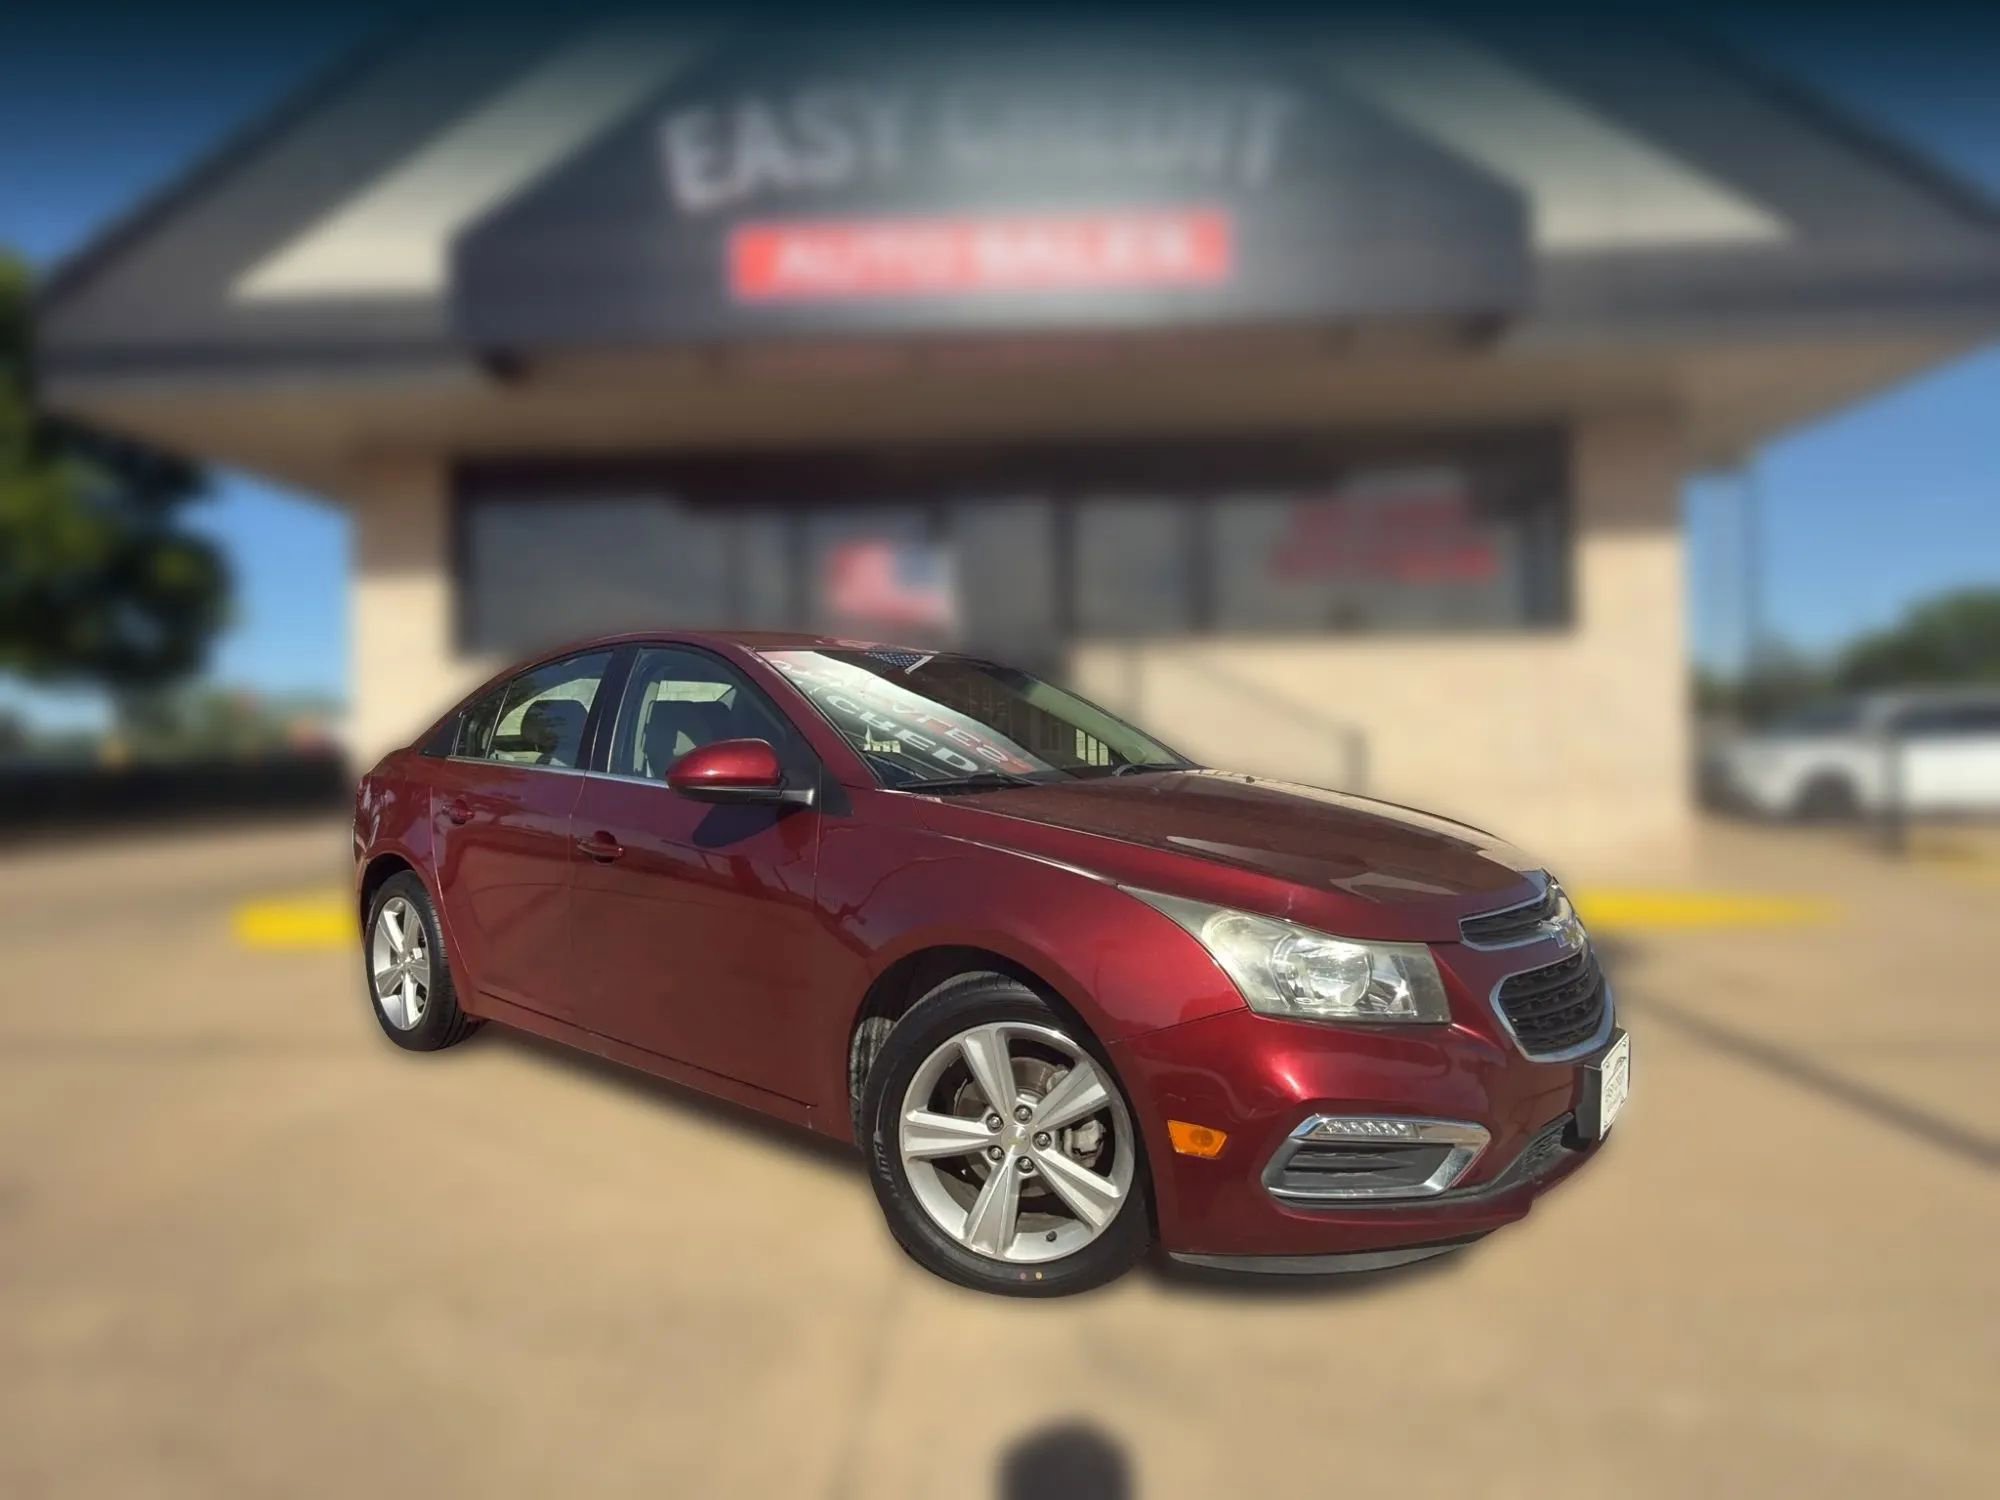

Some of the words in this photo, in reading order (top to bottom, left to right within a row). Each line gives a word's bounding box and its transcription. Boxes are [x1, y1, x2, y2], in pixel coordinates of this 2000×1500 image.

[662, 90, 905, 210] EASY
[774, 226, 951, 286] AUTO
[968, 220, 1194, 280] SALES
